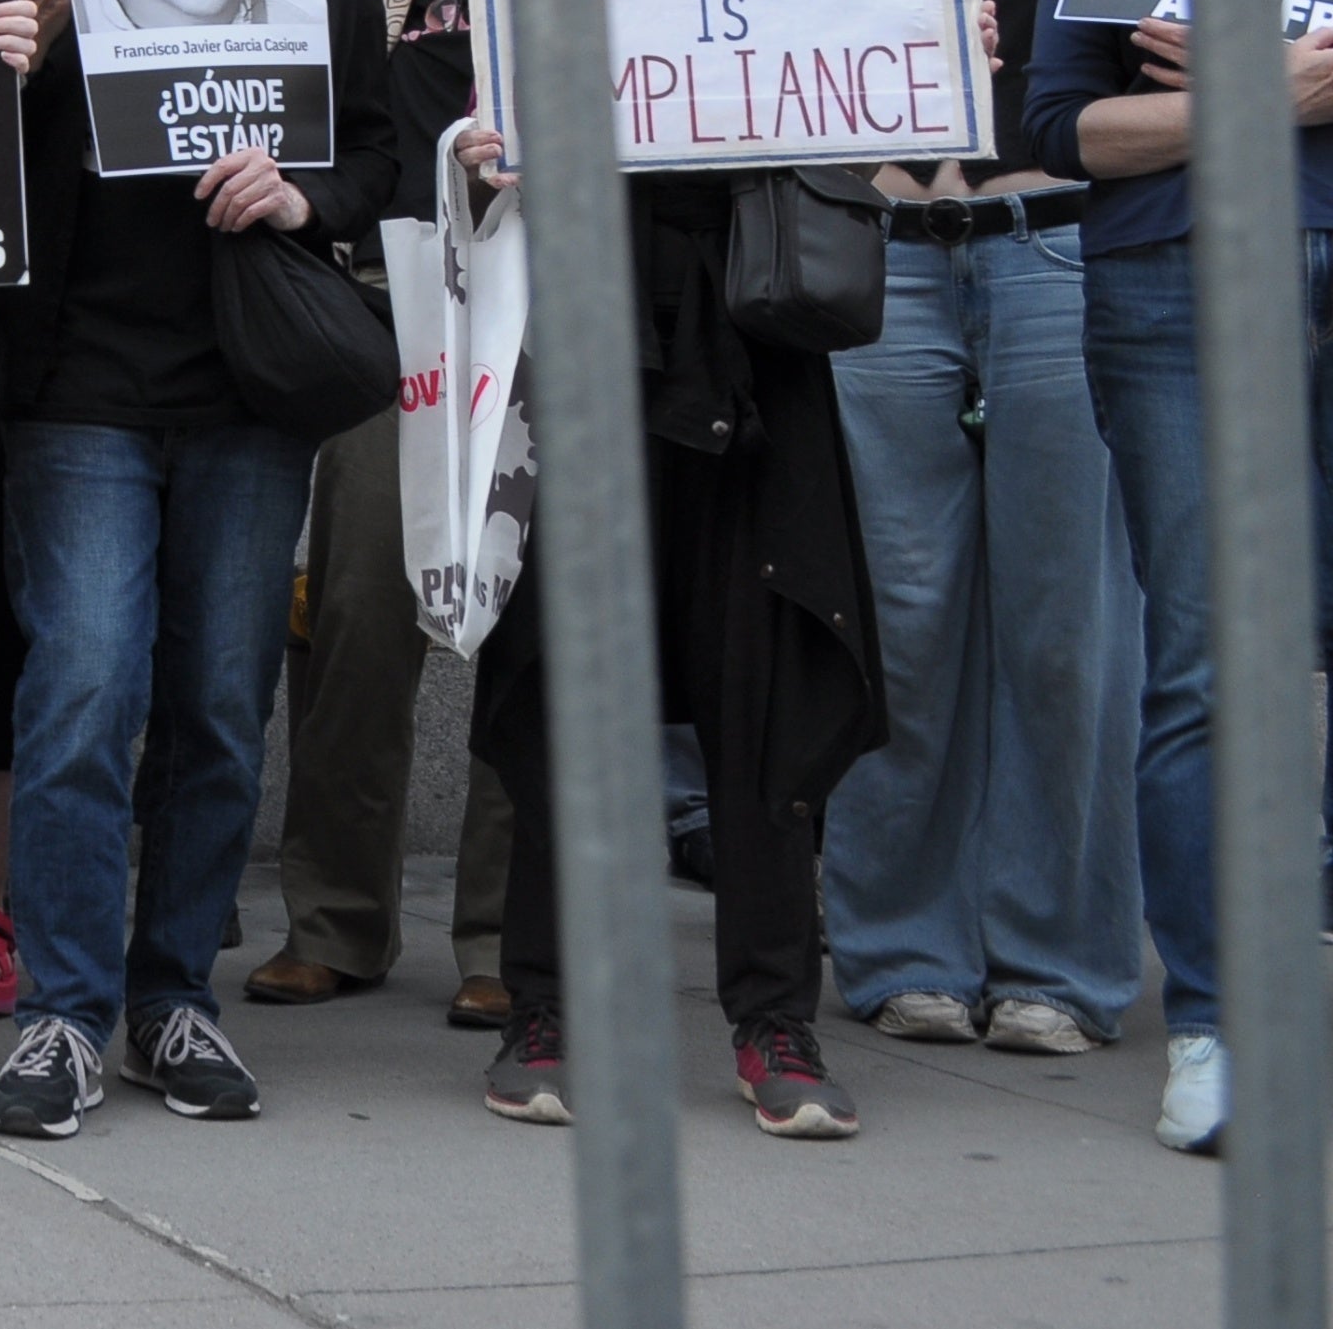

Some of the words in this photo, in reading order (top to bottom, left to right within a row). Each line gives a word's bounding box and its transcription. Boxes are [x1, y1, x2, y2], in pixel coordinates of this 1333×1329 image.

[114, 42, 180, 59] Francisco
[182, 39, 221, 55] Javier
[224, 38, 263, 53] Garcia
[264, 37, 308, 55] Casique
[158, 69, 285, 125] ¿DÓNDE
[613, 41, 949, 145] MPLIANCE
[167, 113, 284, 161] ESTÁN?
